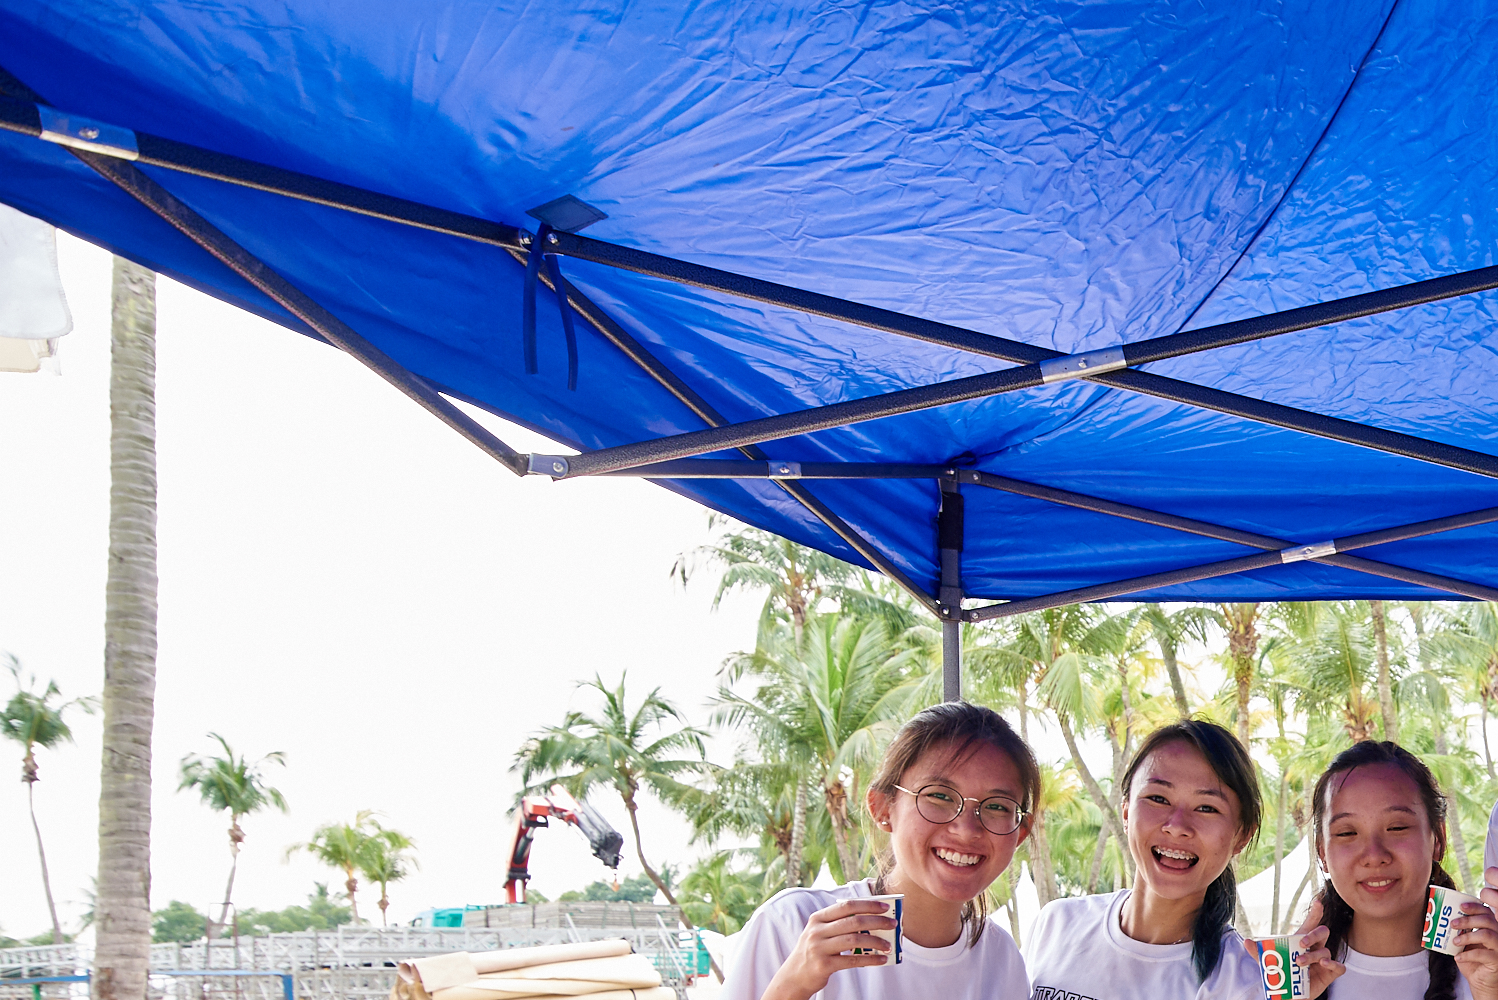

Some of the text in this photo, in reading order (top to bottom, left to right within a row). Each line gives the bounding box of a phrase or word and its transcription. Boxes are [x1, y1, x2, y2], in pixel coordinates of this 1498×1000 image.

[1433, 905, 1453, 949] PLUS
[1264, 949, 1288, 999] 100
[1293, 951, 1302, 996] PLUS
